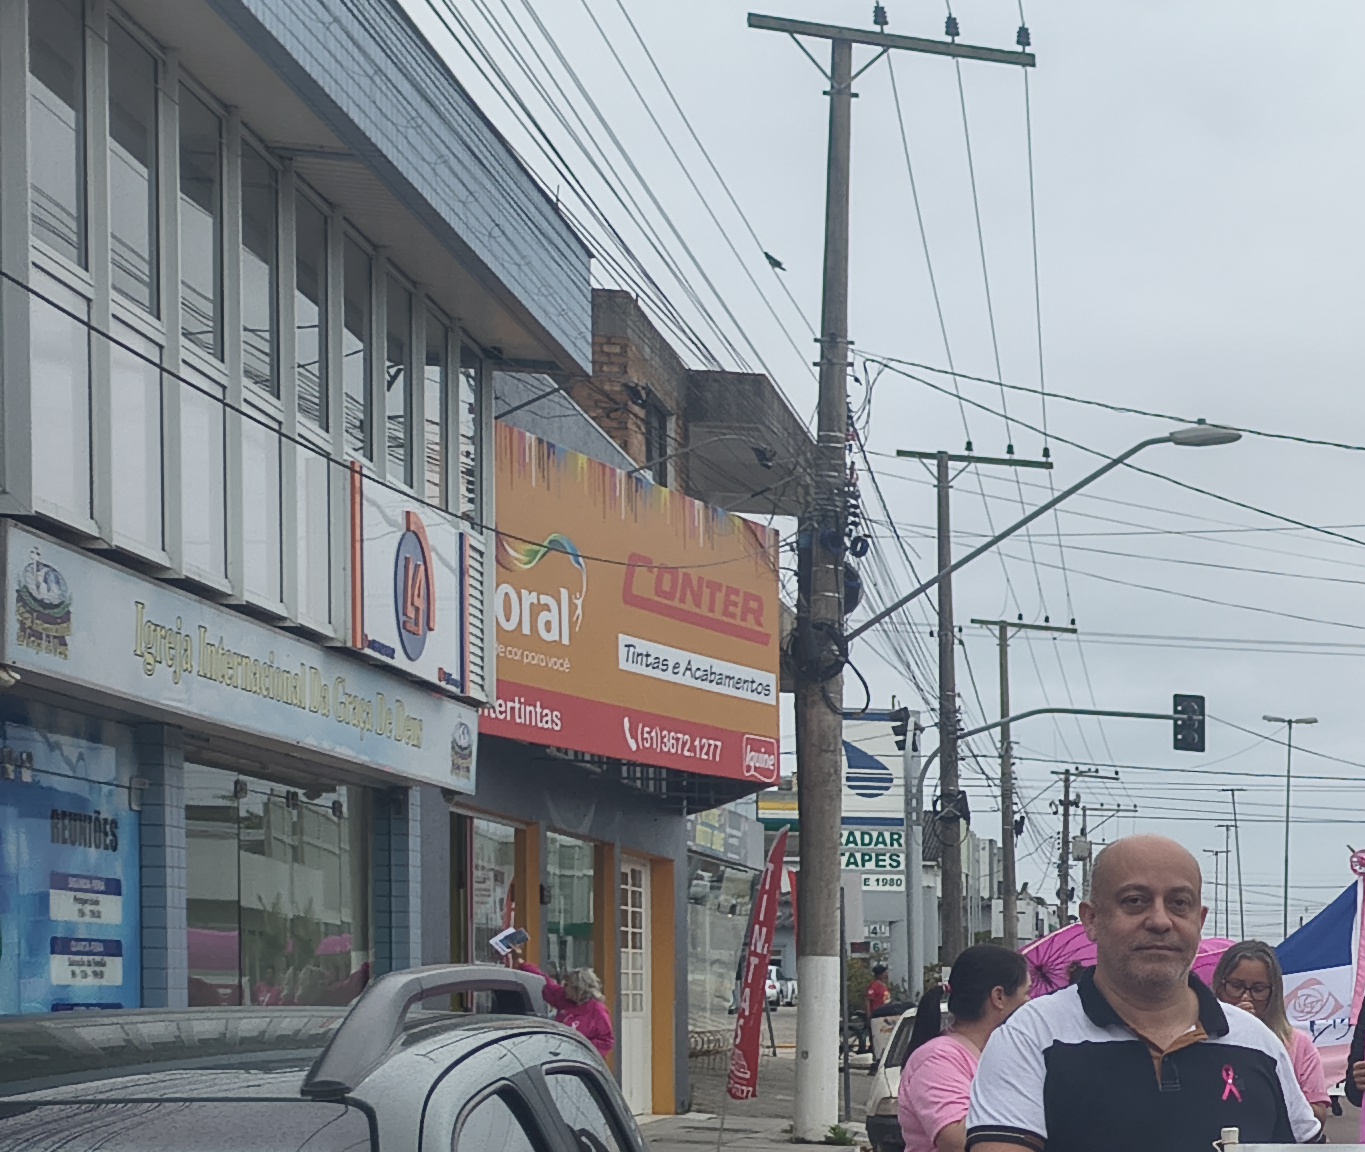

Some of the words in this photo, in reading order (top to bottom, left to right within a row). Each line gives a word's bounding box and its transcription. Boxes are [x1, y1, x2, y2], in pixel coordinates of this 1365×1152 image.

[622, 552, 767, 640] CONTER
[134, 600, 193, 685] Igreja
[197, 624, 306, 710] Internacional
[309, 666, 331, 718] Da
[333, 676, 373, 741] Graça
[375, 692, 393, 740] De
[394, 699, 424, 749] Deus
[624, 643, 669, 673] Tintas
[671, 659, 681, 675] e
[682, 659, 771, 698] Acabamentos
[637, 723, 722, 762] (51)3672.1277
[50, 809, 119, 852] REUNIÕES
[840, 831, 903, 848] ADAR
[874, 877, 903, 887] 1980
